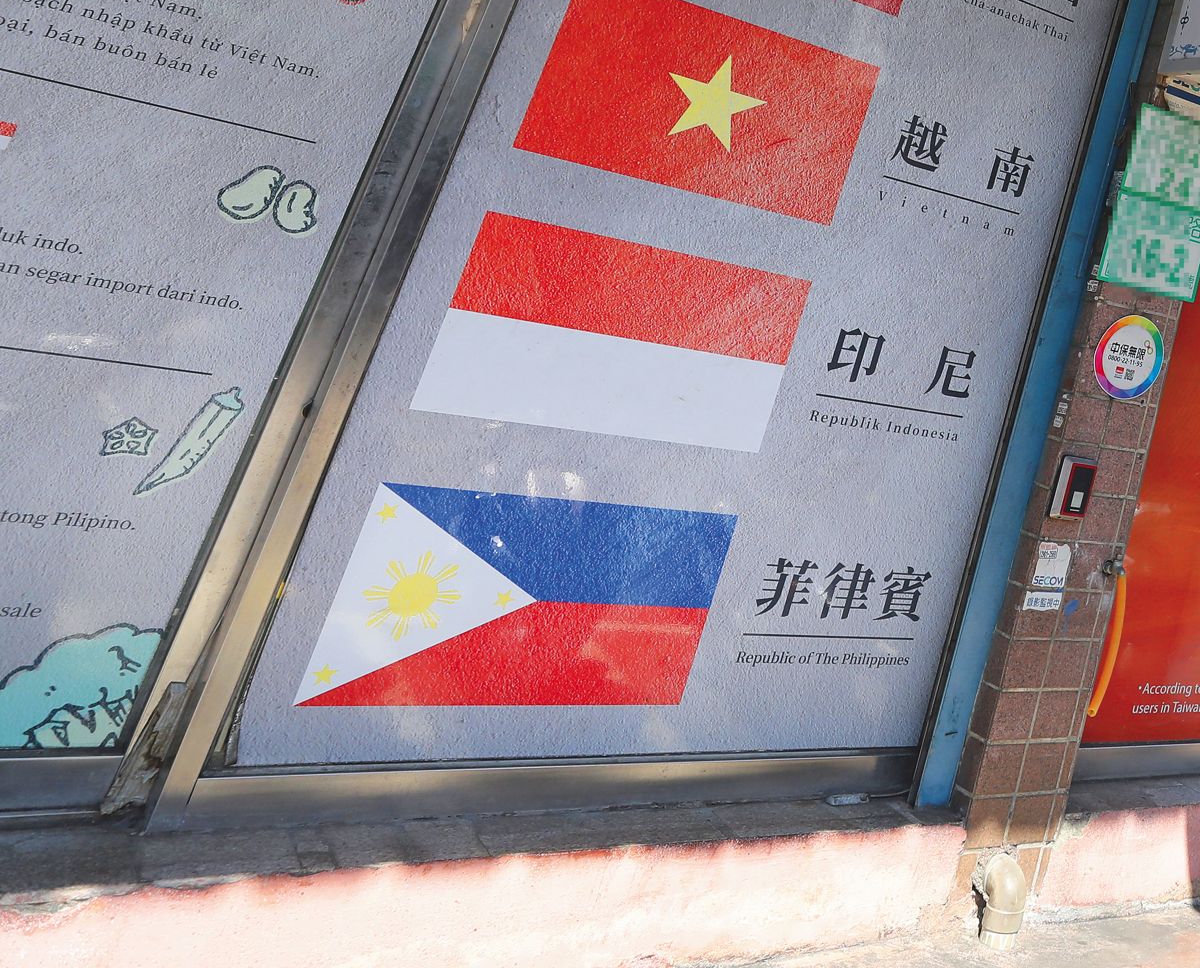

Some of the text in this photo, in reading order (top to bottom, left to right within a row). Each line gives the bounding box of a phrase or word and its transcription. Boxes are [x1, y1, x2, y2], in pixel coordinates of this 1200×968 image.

[44, 24, 86, 47] bán
[93, 36, 147, 62] buôn
[155, 52, 192, 75] bán
[81, 7, 137, 33] nhập
[143, 21, 194, 45] khẩu
[200, 35, 224, 53] từ
[230, 43, 267, 67] Việt
[272, 55, 321, 79] Nam.
[1042, 23, 1069, 43] Thai
[890, 114, 1035, 198] 越南
[877, 190, 1015, 237] Vietnam
[33, 233, 83, 254] indo.
[25, 266, 82, 285] segar
[85, 273, 154, 297] import
[157, 284, 197, 303] dari
[199, 294, 244, 310] indo.
[826, 327, 978, 399] 印尼
[1110, 342, 1147, 361] 中保無限
[808, 409, 960, 443] Republik Indonesia
[51, 511, 136, 532] Pilipino.
[754, 557, 933, 623] 菲律賓
[735, 650, 910, 668] Republic of The Philippines
[1132, 703, 1158, 714] users
[1160, 701, 1170, 713] in
